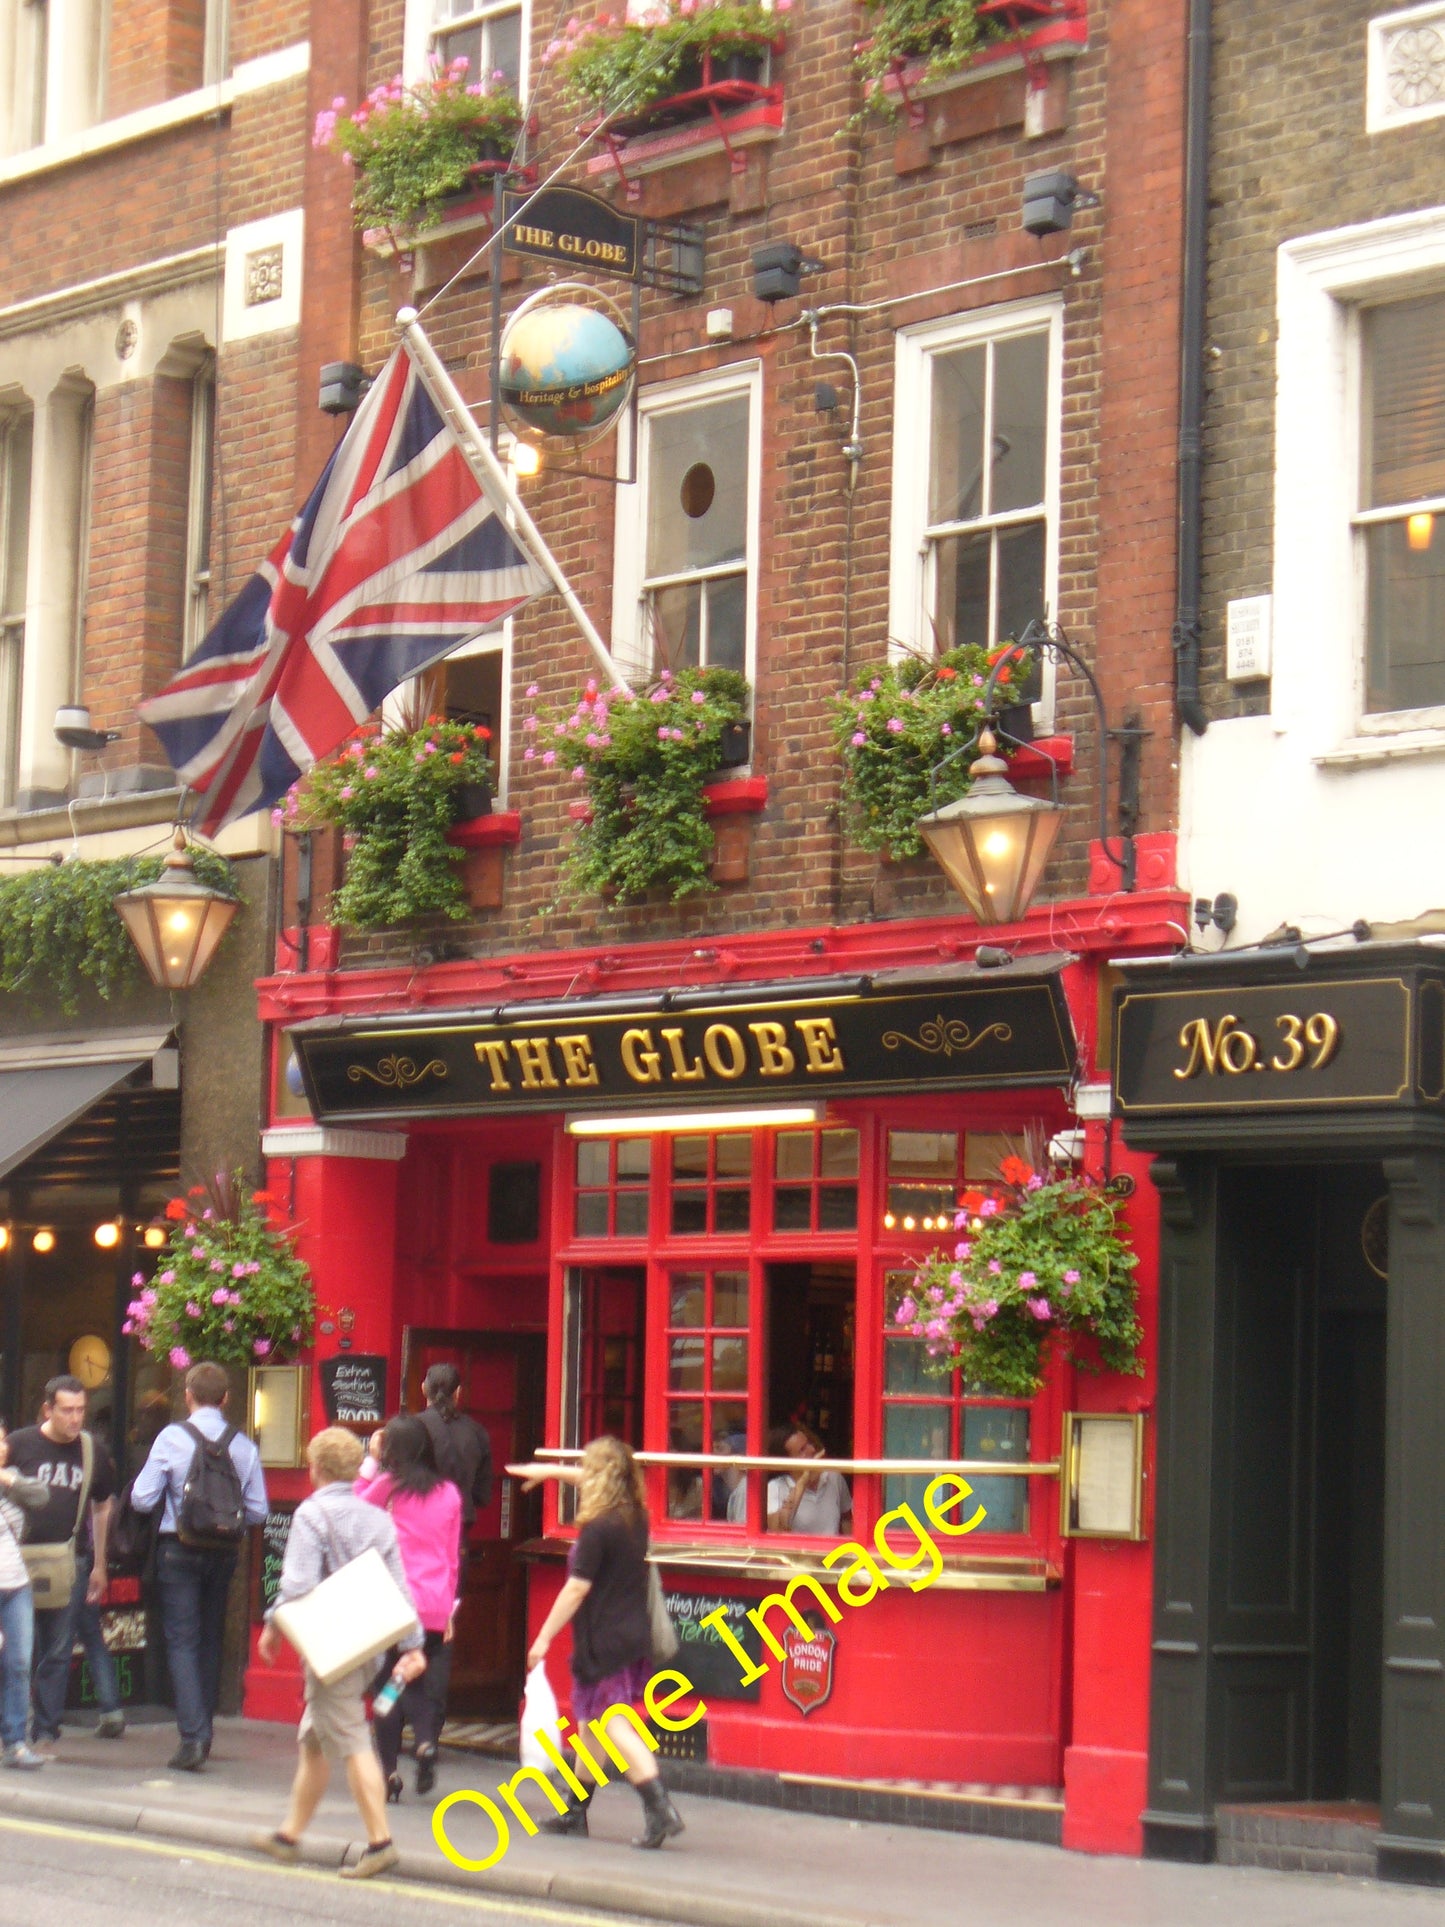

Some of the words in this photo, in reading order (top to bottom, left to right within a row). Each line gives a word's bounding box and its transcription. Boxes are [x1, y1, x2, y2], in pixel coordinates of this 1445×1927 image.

[513, 224, 554, 248] THE
[559, 234, 627, 262] GLOBE
[520, 390, 565, 406] Heritage
[474, 1034, 600, 1091] THE
[621, 1018, 845, 1084] GLOBE
[336, 1364, 371, 1378] Extra
[37, 1462, 83, 1490] GAP
[789, 1644, 828, 1662] LONDON
[794, 1659, 823, 1673] PRIDE
